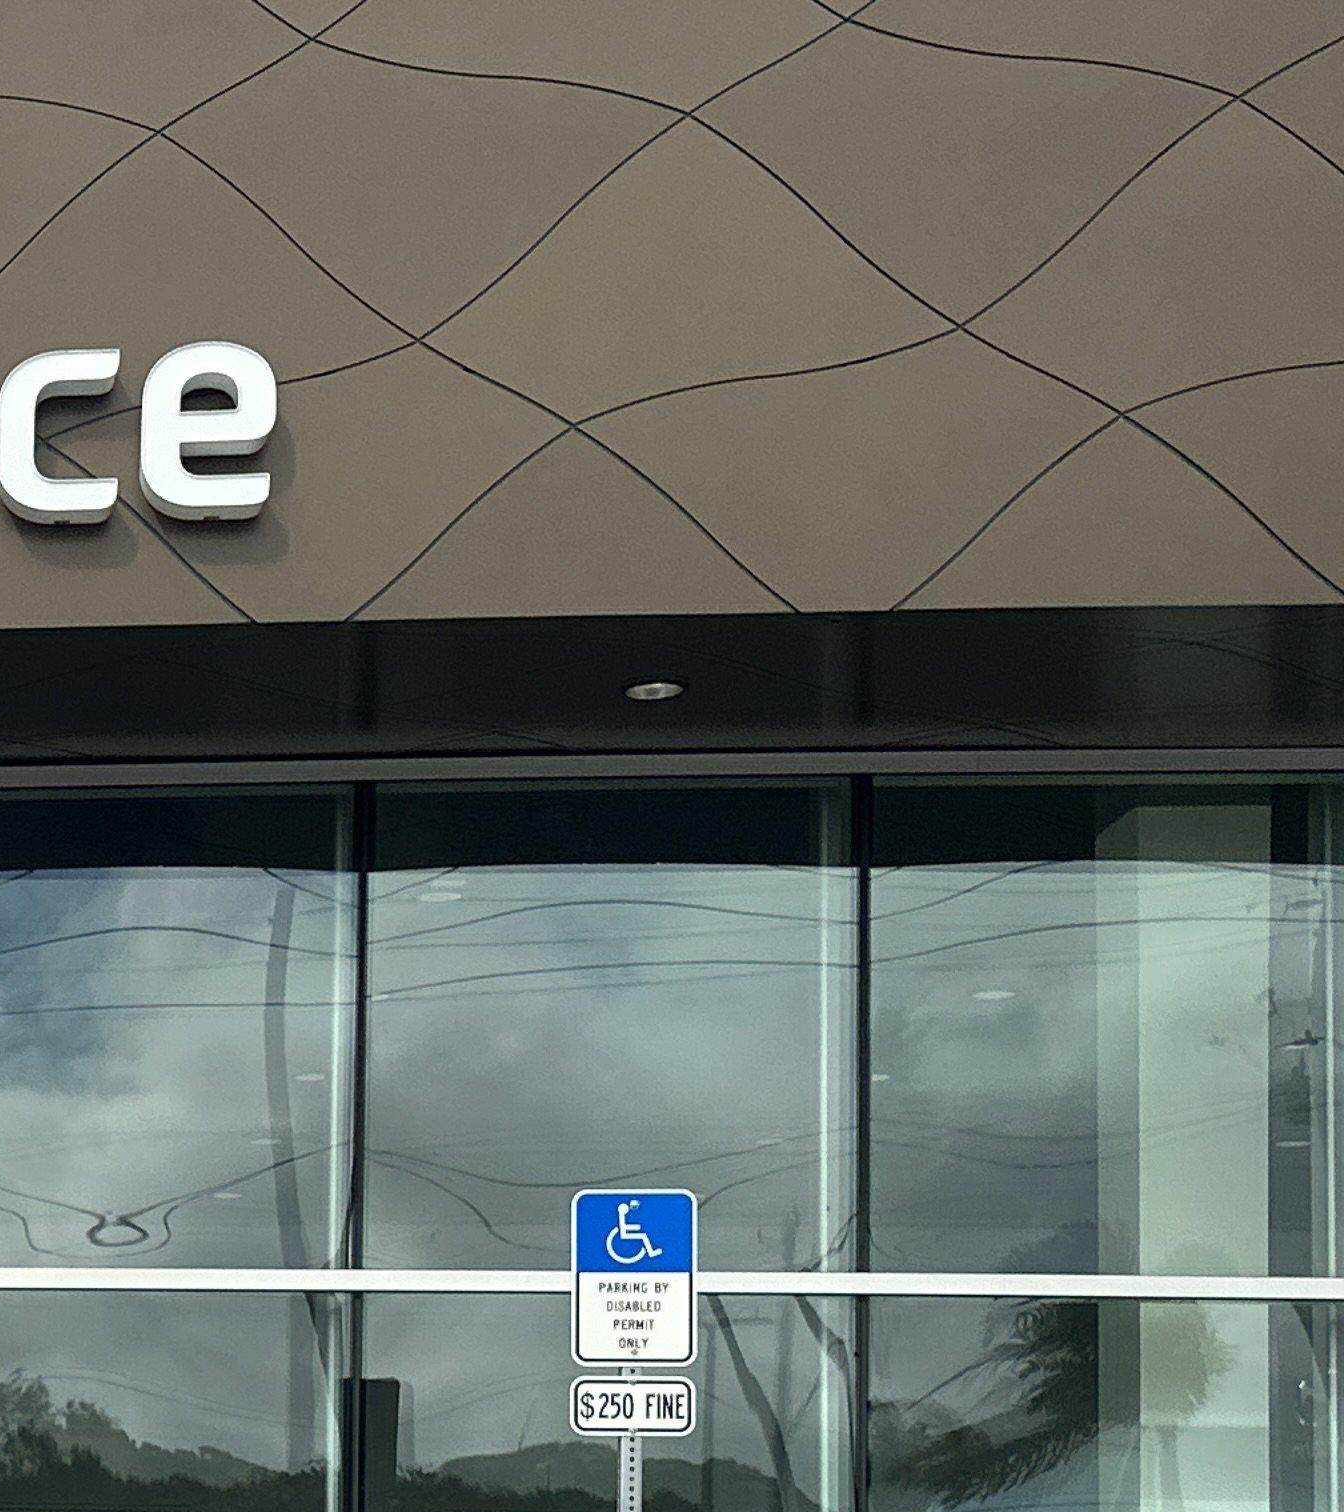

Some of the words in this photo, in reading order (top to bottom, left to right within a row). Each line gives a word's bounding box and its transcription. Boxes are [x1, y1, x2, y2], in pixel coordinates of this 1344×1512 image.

[598, 1282, 648, 1293] PARKING
[655, 1282, 669, 1293] BY
[606, 1302, 662, 1312] DISABLED
[613, 1320, 654, 1330] PERMIT
[619, 1338, 648, 1349] ONLY
[580, 1391, 634, 1421] $250
[646, 1394, 685, 1419] FINE
